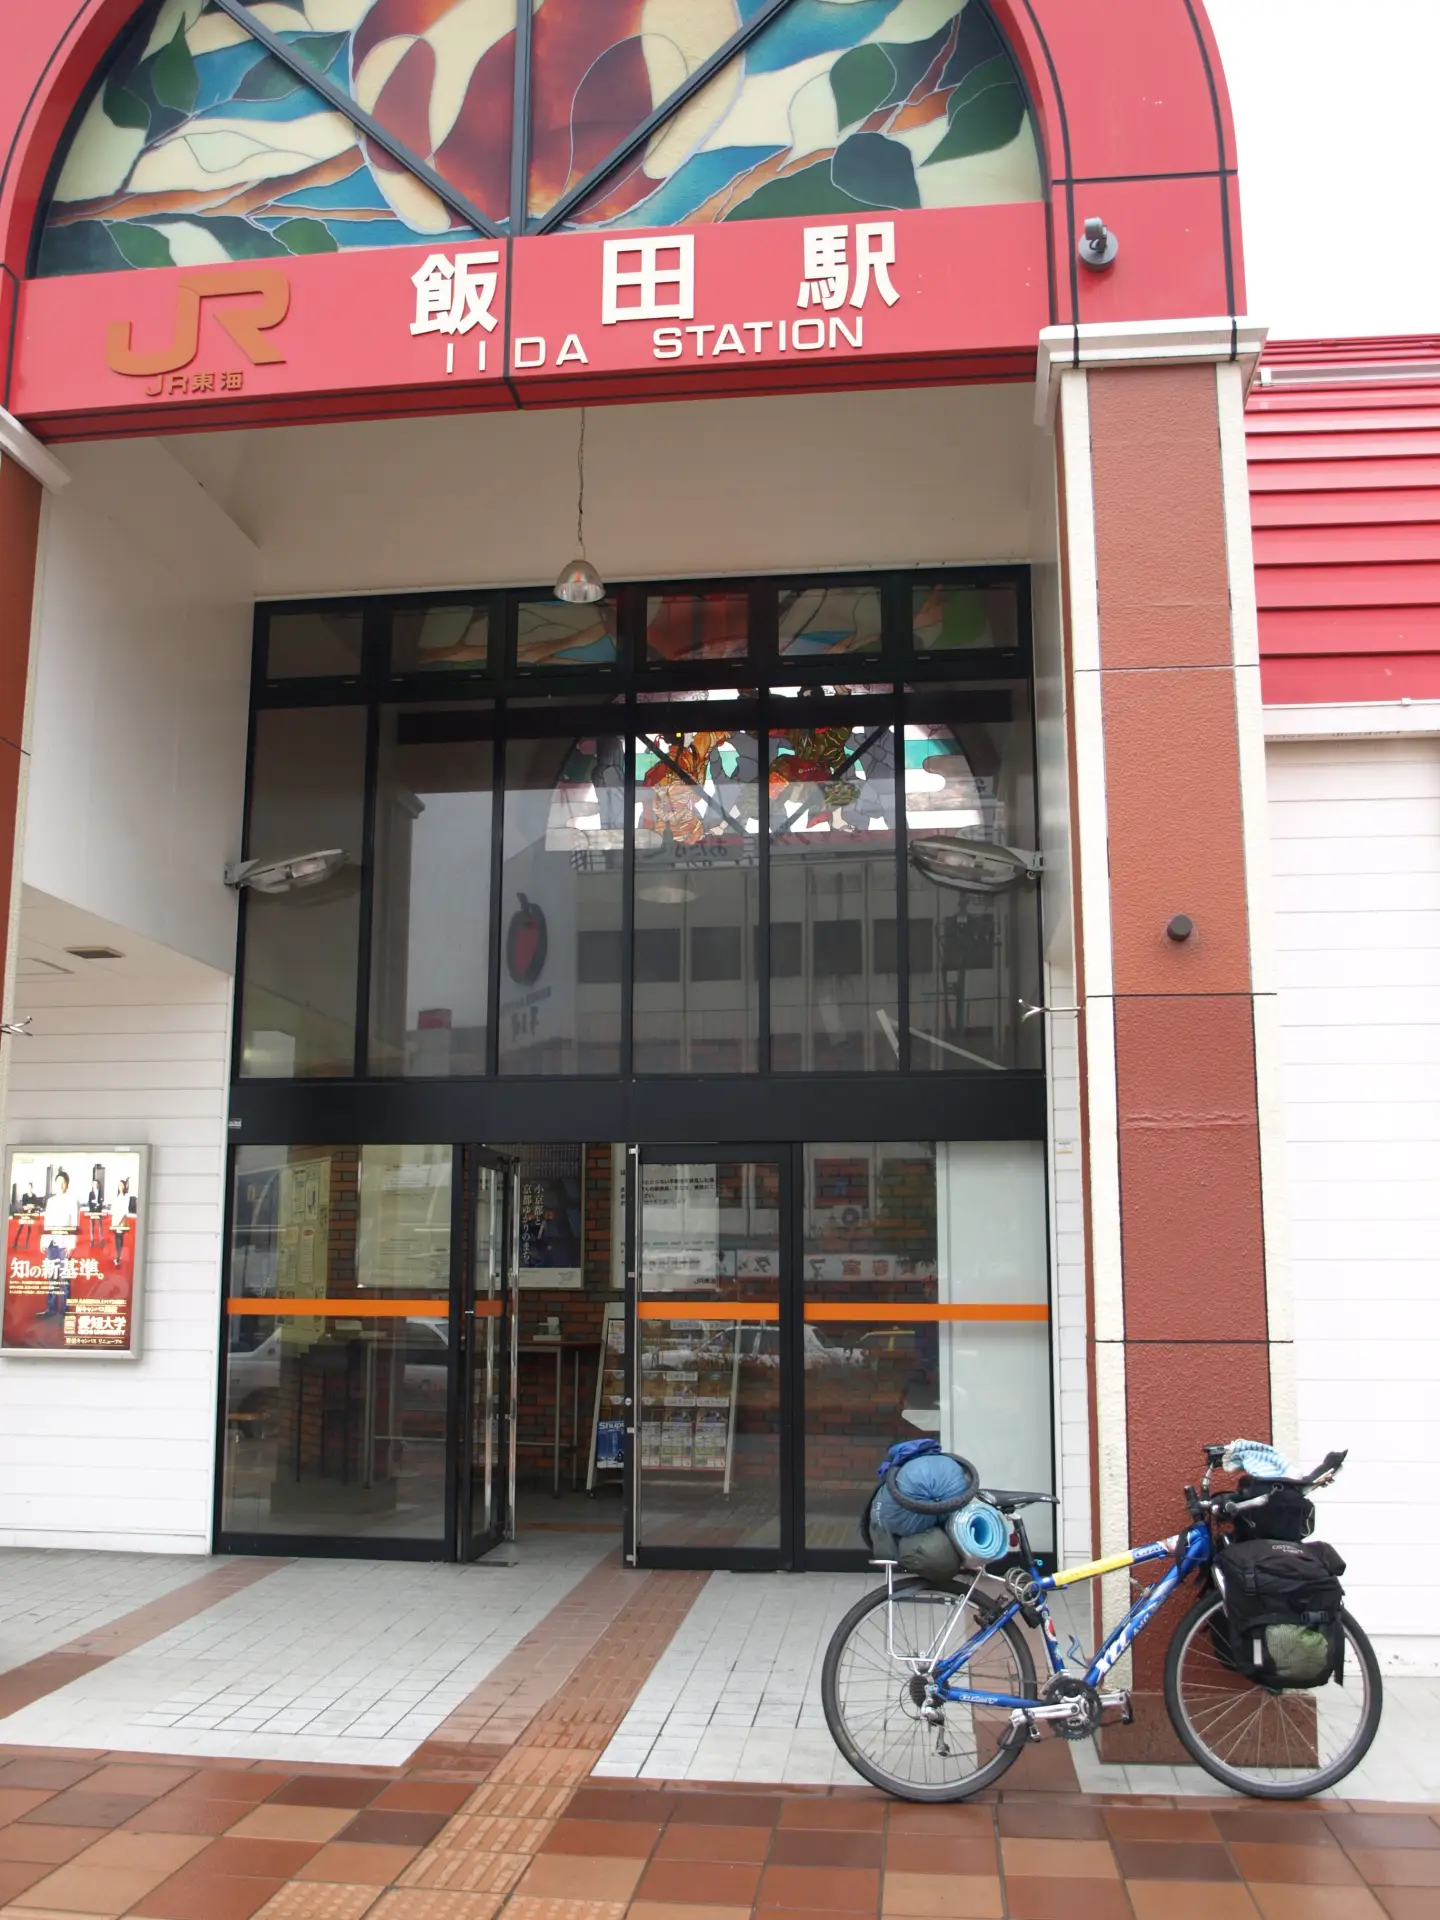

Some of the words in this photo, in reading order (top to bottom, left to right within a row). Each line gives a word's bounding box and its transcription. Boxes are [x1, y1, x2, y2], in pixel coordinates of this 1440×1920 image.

[410, 222, 900, 336] 飯田駅
[105, 269, 290, 377] JR
[446, 333, 588, 374] IIDA
[653, 315, 864, 360] STATION
[146, 371, 244, 396] JR東海
[10, 1256, 104, 1280] 知の新基準。
[77, 1315, 127, 1330] 愛知大学
